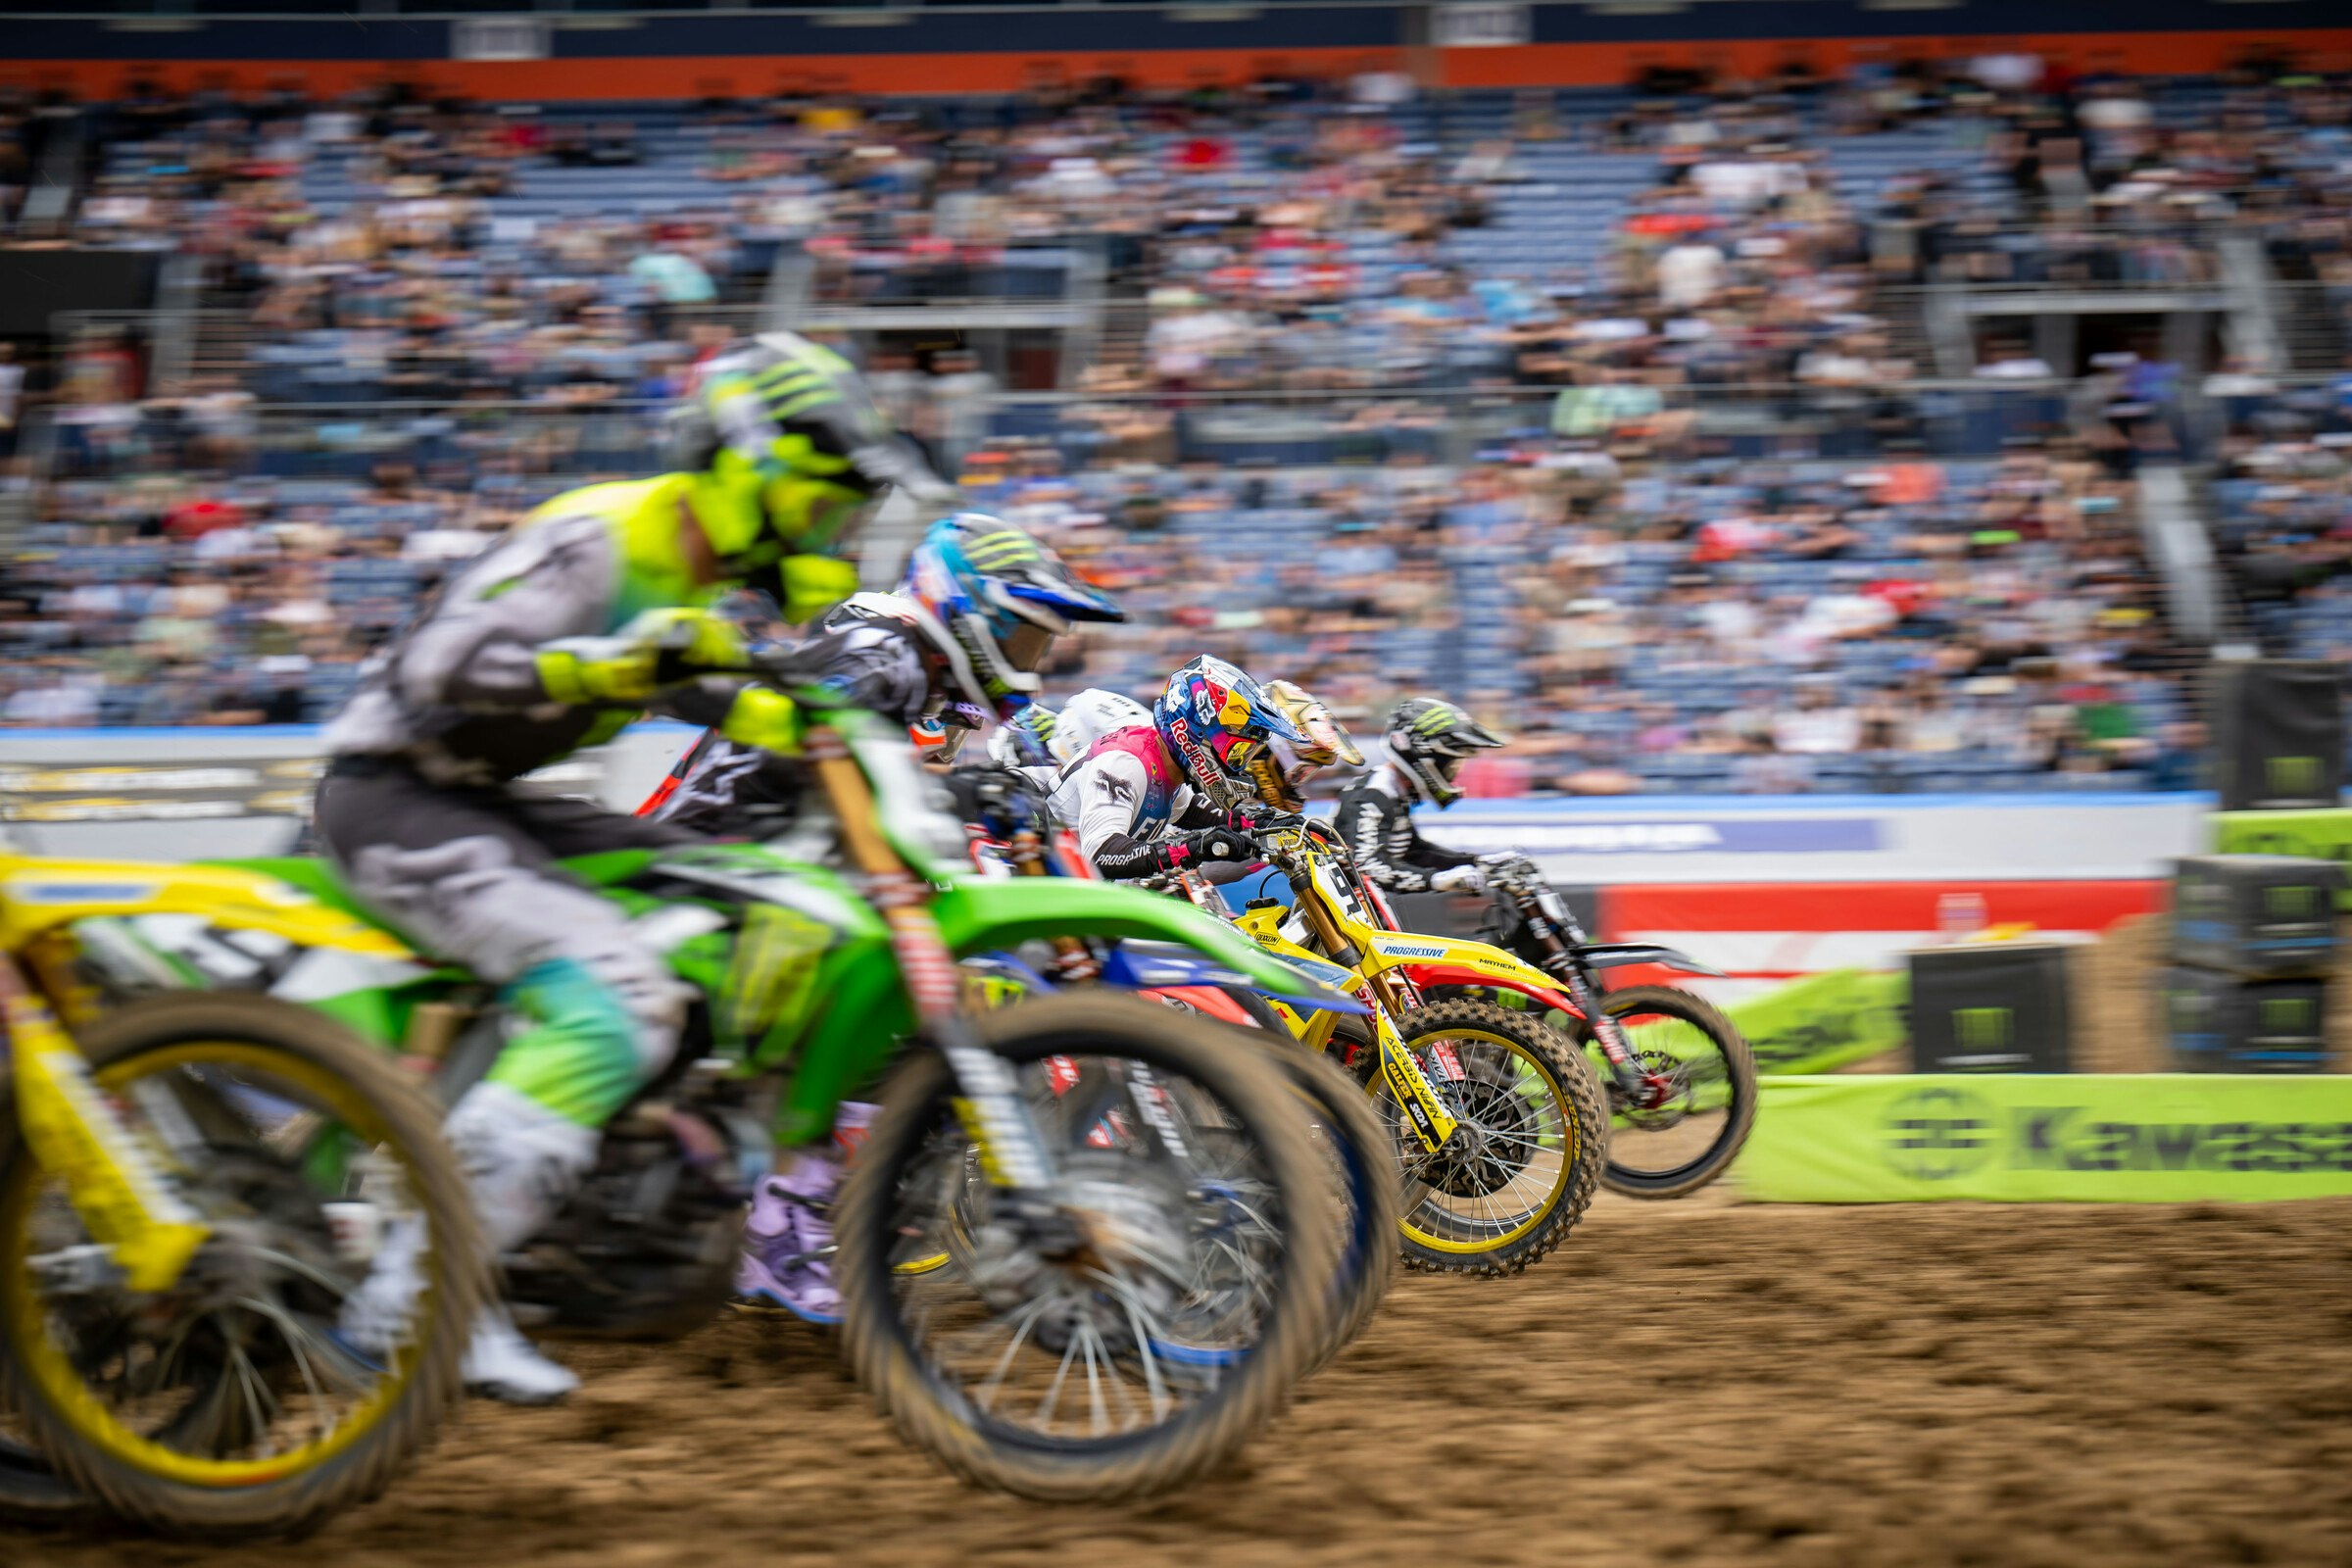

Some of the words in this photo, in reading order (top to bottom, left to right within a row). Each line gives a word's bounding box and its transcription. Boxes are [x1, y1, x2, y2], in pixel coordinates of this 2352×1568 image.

[1170, 717, 1200, 757] Red
[1189, 750, 1221, 786] Bull
[1095, 844, 1152, 866] PROGRSSIVE
[1383, 946, 1446, 957] PROGRESSIVE
[1479, 957, 1516, 971] MAYHEM
[1386, 1036, 1418, 1083] ACERBIS
[1388, 1063, 1412, 1099] GALFER
[1409, 1102, 1429, 1128] SKDA
